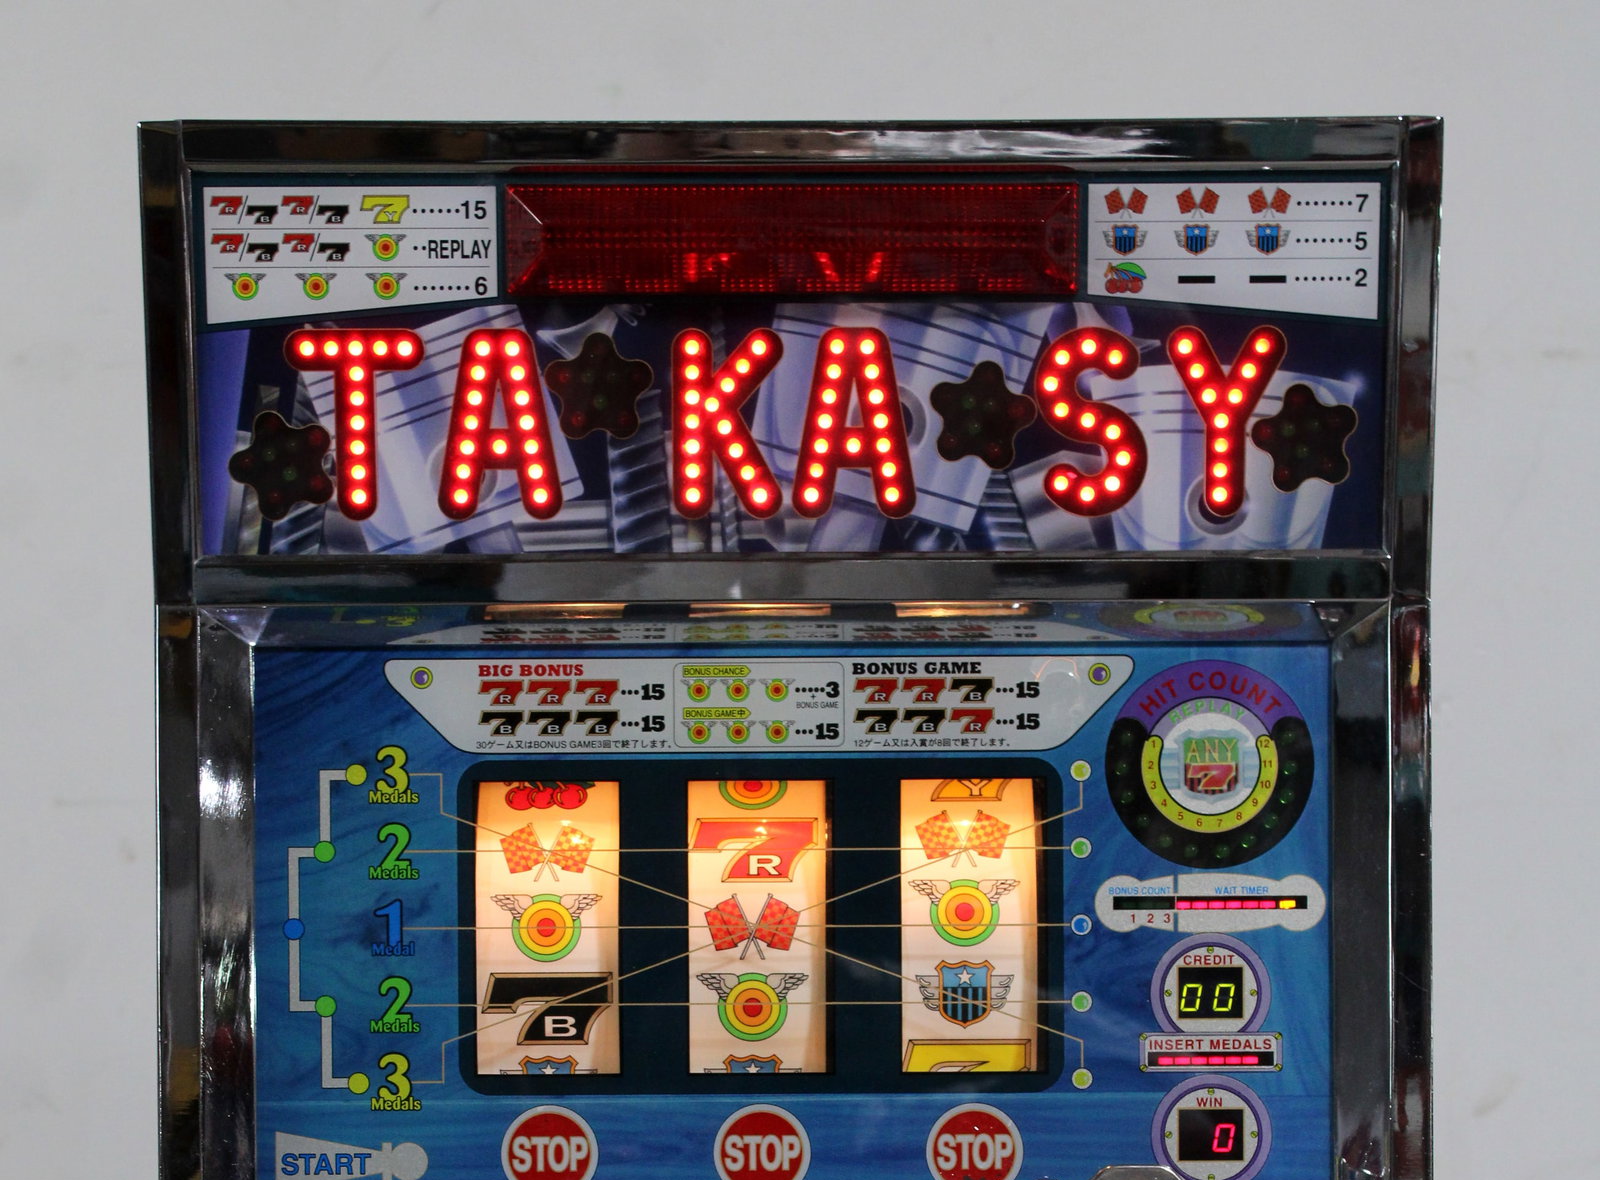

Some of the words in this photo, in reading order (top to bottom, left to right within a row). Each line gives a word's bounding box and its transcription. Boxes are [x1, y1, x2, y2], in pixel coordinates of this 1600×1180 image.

[1355, 194, 1369, 213] 7
[427, 239, 492, 260] REPLAY
[1354, 232, 1368, 250] 5
[474, 276, 488, 296] 6
[1354, 268, 1368, 288] 2
[478, 665, 513, 677] BIG
[520, 664, 584, 677] BONUS
[684, 668, 712, 676] BONUS
[713, 668, 745, 676] CHANCE
[852, 662, 918, 674] BONUS
[924, 662, 982, 674] GAME
[1139, 679, 1179, 717] HIT
[1188, 671, 1282, 714] COUNT
[685, 710, 712, 718] BONUS
[1168, 699, 1247, 725] REPLAY
[1186, 739, 1238, 764] ANY
[1258, 739, 1270, 748] 12
[375, 745, 409, 794] 3
[1262, 760, 1273, 769] 11
[1187, 762, 1236, 790] 7
[1260, 780, 1272, 790] 10
[368, 790, 420, 805] Medals
[377, 822, 412, 870] 2
[368, 866, 420, 880] Medals
[747, 853, 782, 876] R
[1108, 886, 1138, 896] BONUS
[1141, 886, 1171, 896] COUNT
[1214, 886, 1238, 895] WAIT
[1241, 886, 1269, 895] TIMER
[373, 898, 404, 946] 1
[1147, 914, 1154, 924] 2
[1164, 914, 1171, 924] 3
[372, 943, 416, 957] Medal
[1183, 954, 1236, 966] CREDIT
[378, 976, 413, 1024] 2
[370, 1020, 421, 1034] Medals
[543, 1015, 578, 1038] B
[1149, 1039, 1204, 1050] INSERT
[1210, 1038, 1272, 1050] MEDALS
[378, 1052, 412, 1101] 3
[371, 1097, 422, 1112] Medals
[1196, 1096, 1223, 1108] WIN
[512, 1136, 589, 1173] STOP
[724, 1134, 801, 1172] STOP
[936, 1133, 1014, 1171] STOP
[281, 1153, 372, 1176] START
